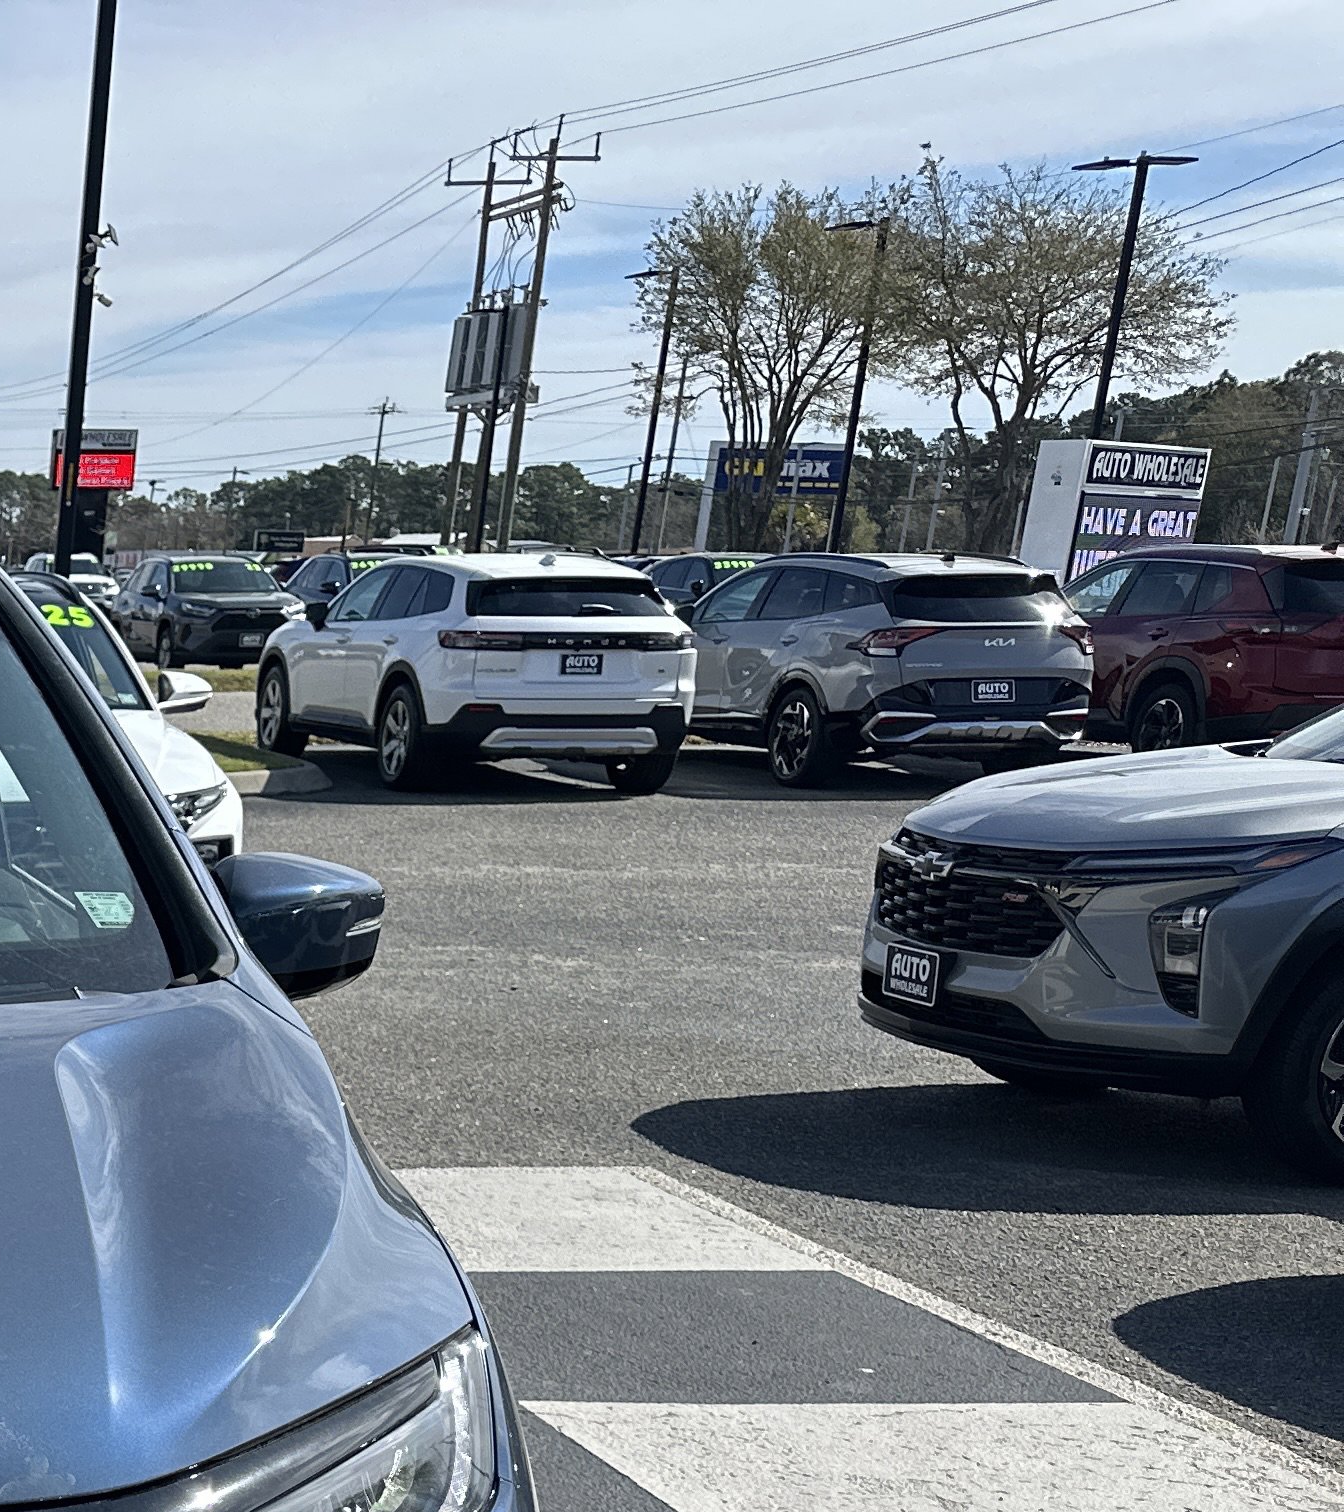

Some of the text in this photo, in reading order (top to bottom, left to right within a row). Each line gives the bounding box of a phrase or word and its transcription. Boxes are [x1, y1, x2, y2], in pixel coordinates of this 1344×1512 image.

[1092, 451, 1206, 486] AUTO WHOLESALE
[1080, 507, 1197, 538] HAVE A GREAT
[41, 604, 95, 628] 25
[565, 656, 598, 667] AUTO
[977, 682, 1009, 694] AUTO
[891, 953, 931, 982] AUTO
[890, 977, 928, 997] WHOLESALE
